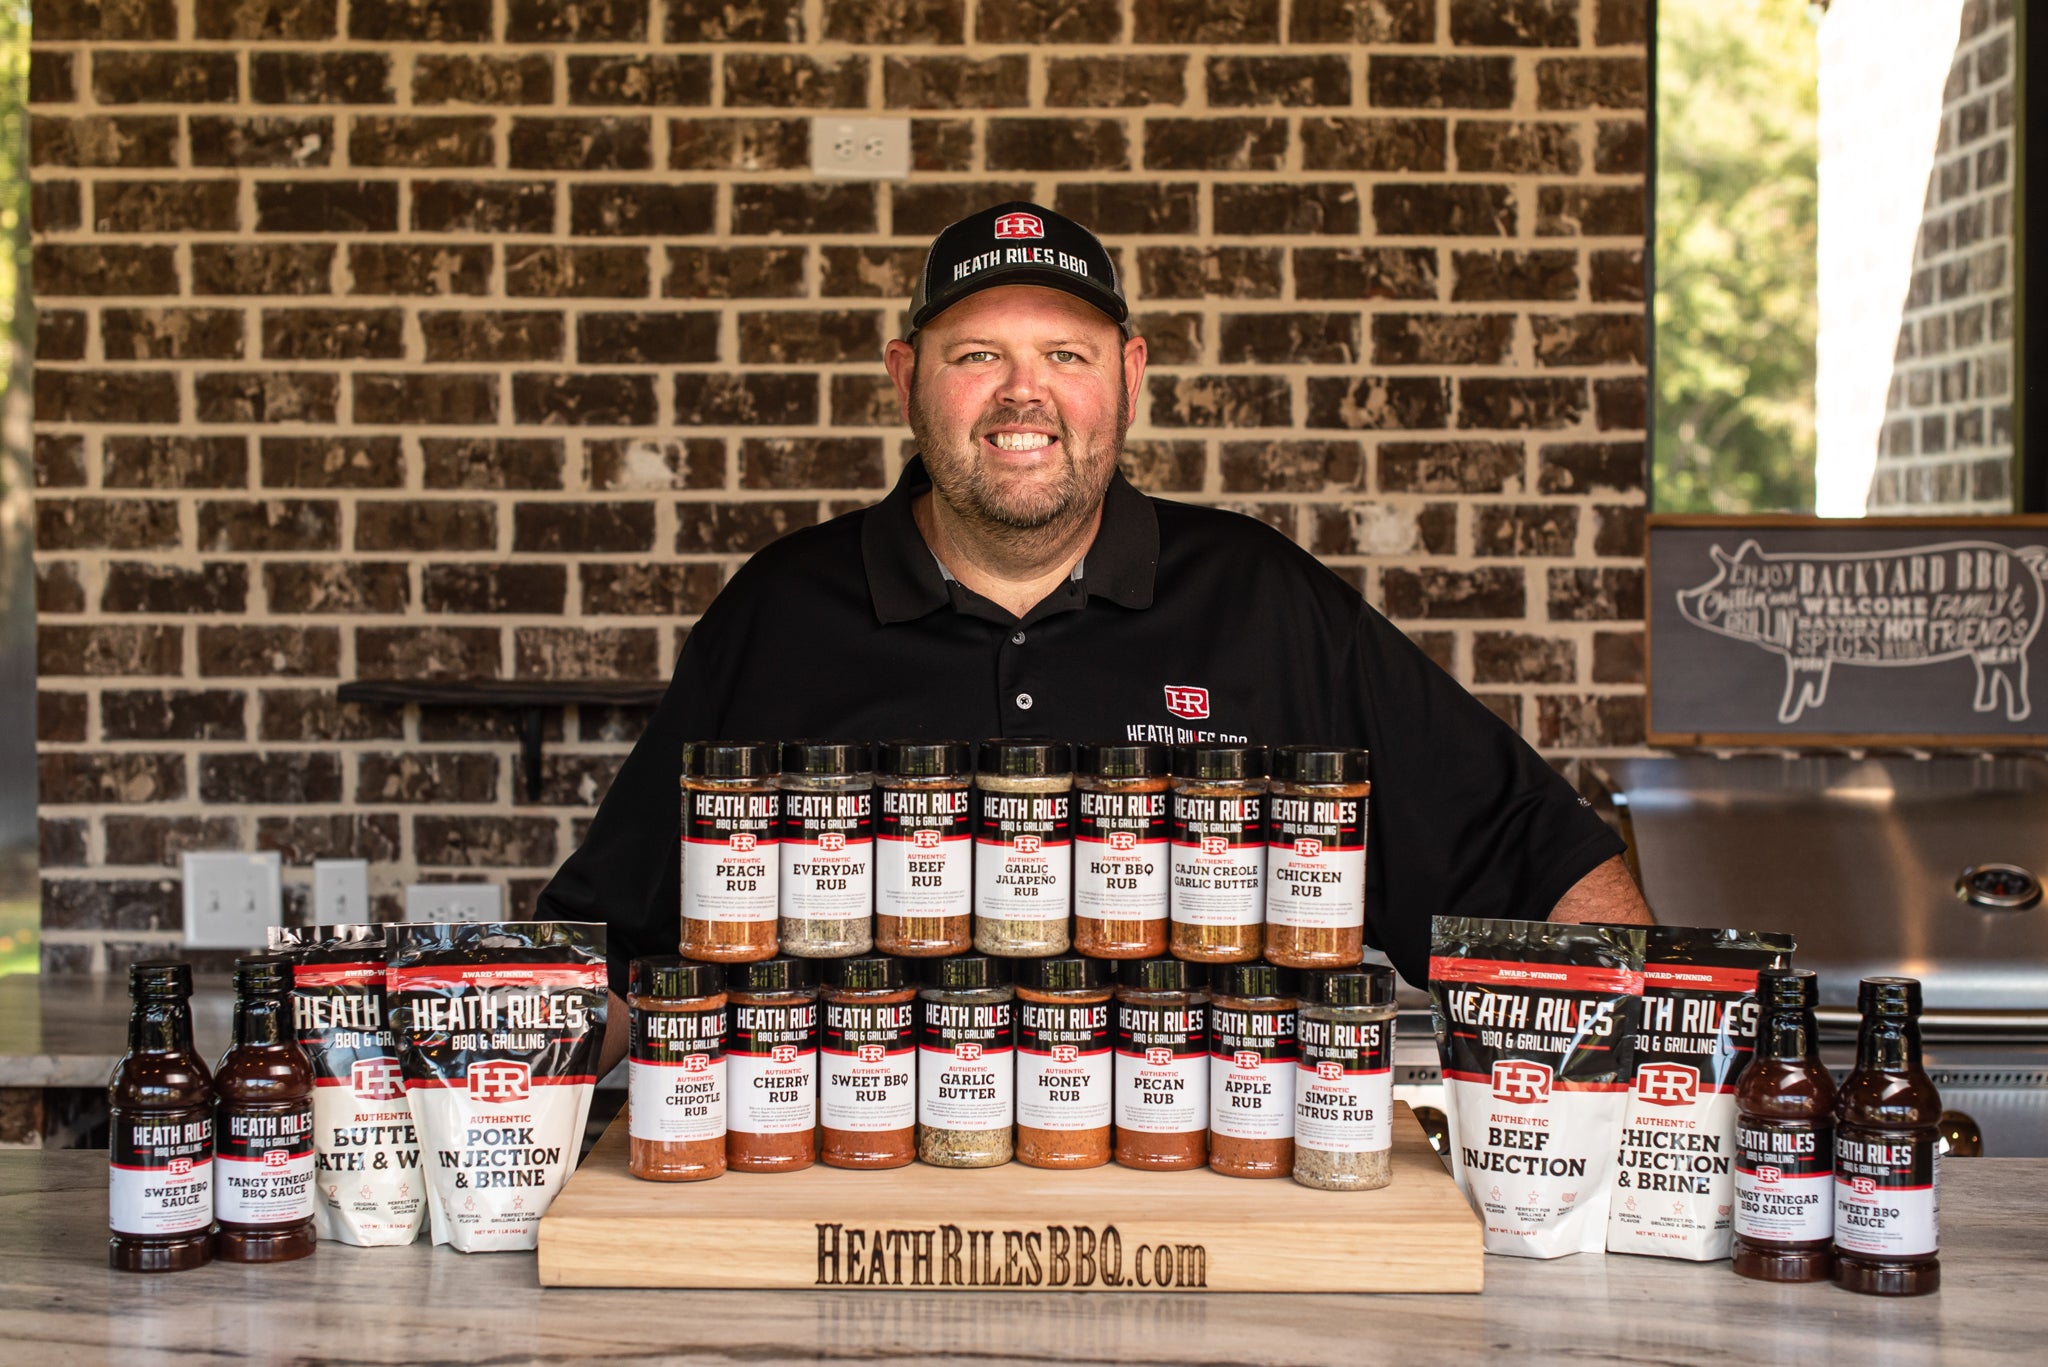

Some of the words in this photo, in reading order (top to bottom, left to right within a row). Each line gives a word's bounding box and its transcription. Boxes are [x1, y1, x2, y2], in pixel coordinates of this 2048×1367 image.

[995, 214, 1044, 238] HR
[954, 249, 1000, 281] HEATH
[1006, 247, 1054, 265] RILES
[1799, 555, 1946, 596] BACKYARD
[1801, 596, 1928, 615] WELCOME
[1884, 618, 1927, 641] HOT
[1929, 620, 2029, 652] FRIENDS
[1127, 724, 1173, 744] HEATH
[695, 794, 744, 817] HEATH
[749, 796, 779, 818] RILES
[787, 794, 832, 817] HEATH
[836, 794, 871, 818] RILES
[884, 792, 927, 814] HEATH
[932, 792, 968, 815] RILES
[984, 796, 1028, 819] HEATH
[1032, 798, 1068, 820] RILES
[1081, 793, 1123, 816] HEATH
[1128, 794, 1165, 816] RILES
[1174, 798, 1215, 821] HEATH
[1219, 799, 1260, 821] RILES
[1271, 799, 1308, 823] HEATH
[1313, 802, 1356, 824] RILES
[716, 864, 765, 877] PEACH
[793, 863, 866, 876] EVERYDAY
[908, 861, 946, 873] BEEF
[1005, 864, 1049, 875] GARLIC
[1090, 862, 1121, 875] HOT
[1125, 862, 1154, 876] BBQ
[1175, 863, 1210, 876] CAJUN
[1213, 864, 1258, 877] CREOLE
[1277, 867, 1342, 884] CHICKEN
[726, 880, 757, 892] RUB
[816, 879, 847, 891] RUB
[911, 876, 942, 888] RUB
[995, 873, 1057, 885] JALAPEÑO
[1106, 878, 1137, 890] RUB
[1174, 878, 1211, 889] GARLIC
[1214, 878, 1259, 889] BUTTER
[1014, 887, 1039, 897] RUB
[1291, 885, 1322, 898] RUB
[462, 971, 534, 979] AWARD-WINNING
[1499, 969, 1568, 981] AWARD-WINNING
[294, 995, 381, 1030] HEATH
[412, 995, 498, 1032] HEATH
[506, 994, 583, 1031] RILES
[737, 1007, 786, 1030] HEATH
[790, 1005, 817, 1029] RILES
[828, 1005, 871, 1029] HEATH
[876, 1004, 912, 1029] RILES
[926, 1003, 969, 1027] HEATH
[973, 1004, 1010, 1028] RILES
[1023, 1005, 1064, 1029] HEATH
[1069, 1005, 1107, 1029] RILES
[1119, 1007, 1160, 1032] HEATH
[1164, 1009, 1203, 1032] RILES
[1448, 989, 1530, 1030] HEATH
[1534, 996, 1615, 1037] RILES
[1681, 999, 1760, 1037] RILES
[648, 1015, 697, 1039] HEATH
[1212, 1009, 1247, 1035] HEATH
[1251, 1012, 1294, 1036] RILES
[335, 1031, 360, 1049] BBQ
[452, 1033, 477, 1051] BBQ
[480, 1034, 488, 1050] &
[491, 1033, 545, 1050] GRILLING
[1334, 1024, 1380, 1048] RILES
[1481, 1030, 1503, 1050] BBQ
[1505, 1034, 1513, 1049] &
[1517, 1034, 1572, 1054] GRILLING
[1664, 1036, 1717, 1055] GRILLING
[469, 1062, 531, 1099] HR
[675, 1082, 715, 1094] HONEY
[753, 1074, 810, 1089] CHERRY
[831, 1074, 880, 1087] SWEET
[884, 1073, 909, 1087] BBQ
[940, 1073, 995, 1086] GARLIC
[1038, 1075, 1090, 1087] HONEY
[1134, 1078, 1185, 1091] PECAN
[1225, 1081, 1271, 1095] APPLE
[1494, 1062, 1552, 1101] HR
[1639, 1065, 1699, 1103] HR
[666, 1092, 721, 1105] CHIPOTLE
[769, 1091, 798, 1103] RUB
[855, 1090, 887, 1102] RUB
[938, 1087, 996, 1099] BUTTER
[1049, 1090, 1080, 1102] RUB
[1143, 1093, 1174, 1105] RUB
[1305, 1091, 1357, 1107] SIMPLE
[684, 1107, 708, 1117] RUB
[1232, 1097, 1262, 1109] RUB
[1297, 1103, 1338, 1121] CITRUS
[1343, 1109, 1374, 1121] RUB
[232, 1116, 277, 1136] HEATH
[281, 1112, 313, 1135] RILES
[470, 1114, 531, 1124] AUTHENTIC
[1490, 1113, 1549, 1127] AUTHENTIC
[1635, 1117, 1696, 1129] AUTHENTIC
[133, 1125, 181, 1146] HEATH
[185, 1118, 212, 1143] RILES
[334, 1125, 419, 1147] BUTTE
[467, 1127, 534, 1147] PORK
[1488, 1126, 1550, 1151] BEEF
[1772, 1131, 1815, 1153] RILES
[315, 1150, 366, 1171] ATH
[438, 1147, 560, 1168] INJECTION
[1462, 1146, 1586, 1177] INJECTION
[1618, 1149, 1730, 1174] NJECTION
[1867, 1142, 1911, 1166] RILES
[228, 1177, 267, 1189] TANGY
[455, 1171, 468, 1189] &
[475, 1169, 545, 1188] BRINE
[1618, 1171, 1631, 1188] &
[1637, 1172, 1710, 1195] BRINE
[144, 1186, 186, 1198] SWEET
[190, 1182, 208, 1195] BBQ
[242, 1188, 268, 1200] BBQ
[270, 1184, 306, 1197] SAUCE
[1763, 1193, 1819, 1205] VINEGAR
[162, 1194, 200, 1208] SAUCE
[1741, 1201, 1760, 1213] BBQ
[1762, 1204, 1804, 1216] SAUCE
[1847, 1214, 1885, 1228] SAUCE
[1873, 1206, 1899, 1219] BBQ
